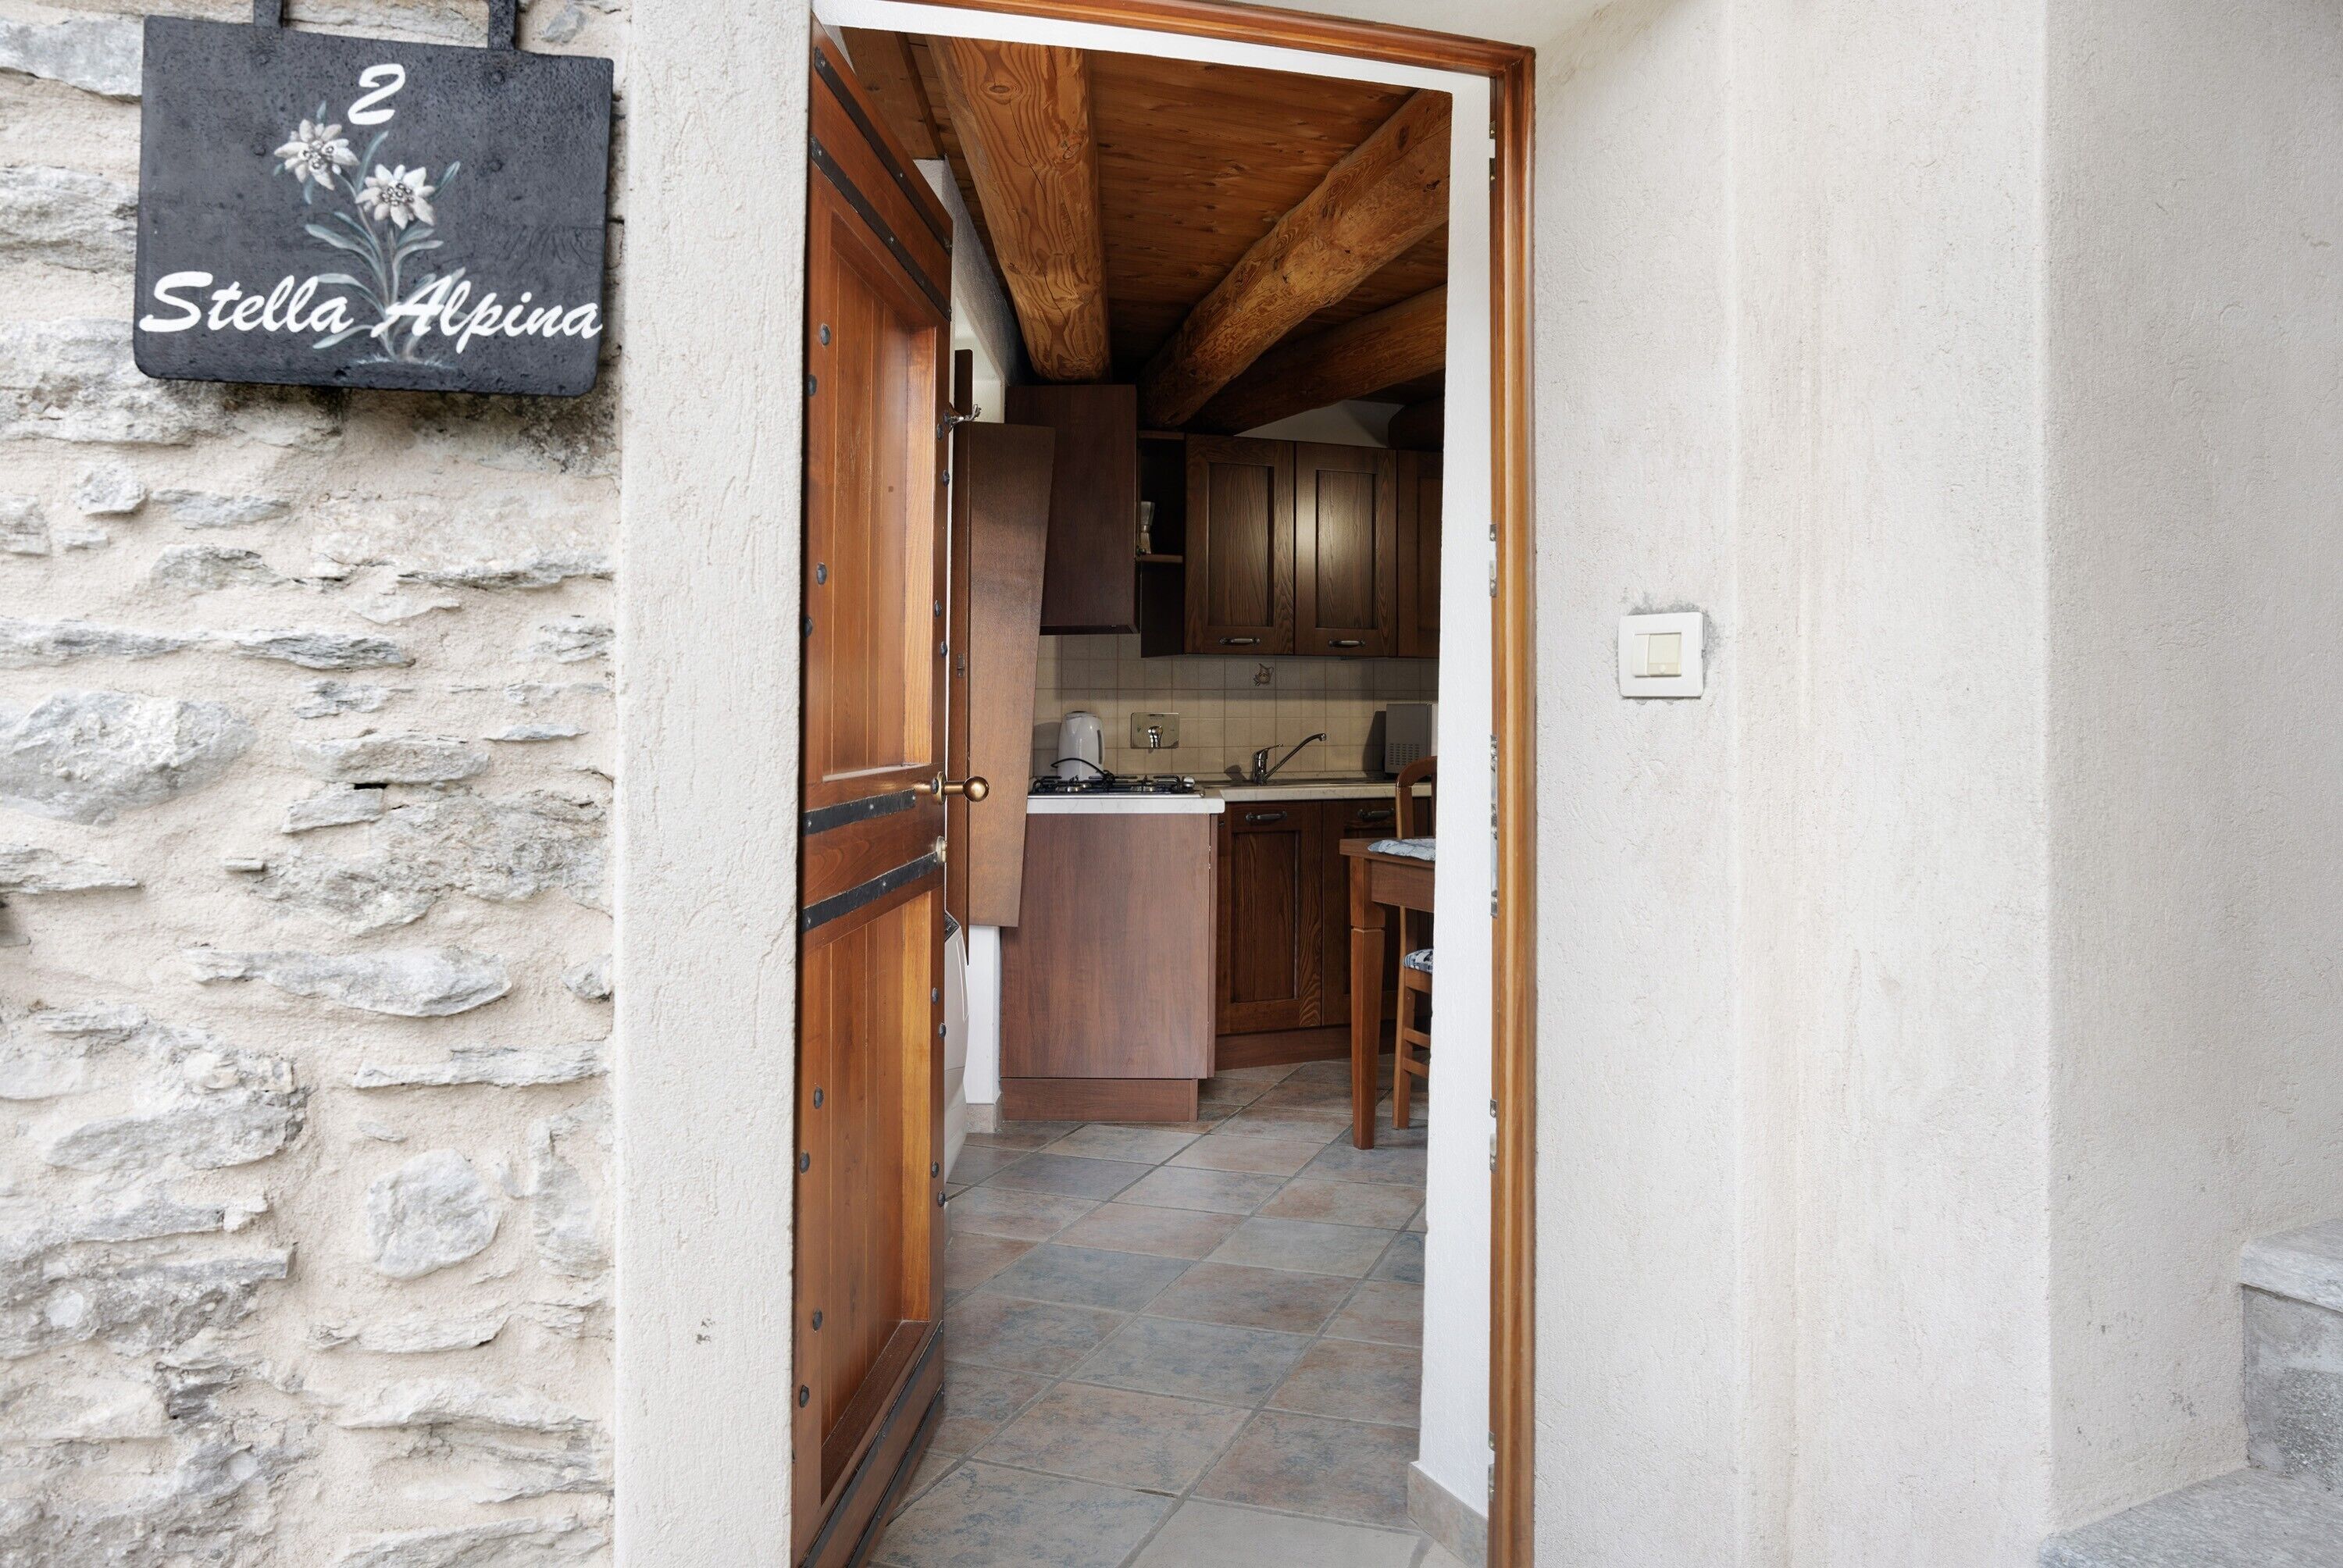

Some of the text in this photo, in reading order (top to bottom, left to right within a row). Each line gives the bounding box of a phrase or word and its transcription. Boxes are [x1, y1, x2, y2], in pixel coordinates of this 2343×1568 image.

[347, 63, 406, 125] 2
[138, 271, 604, 354] Stella Alpina
